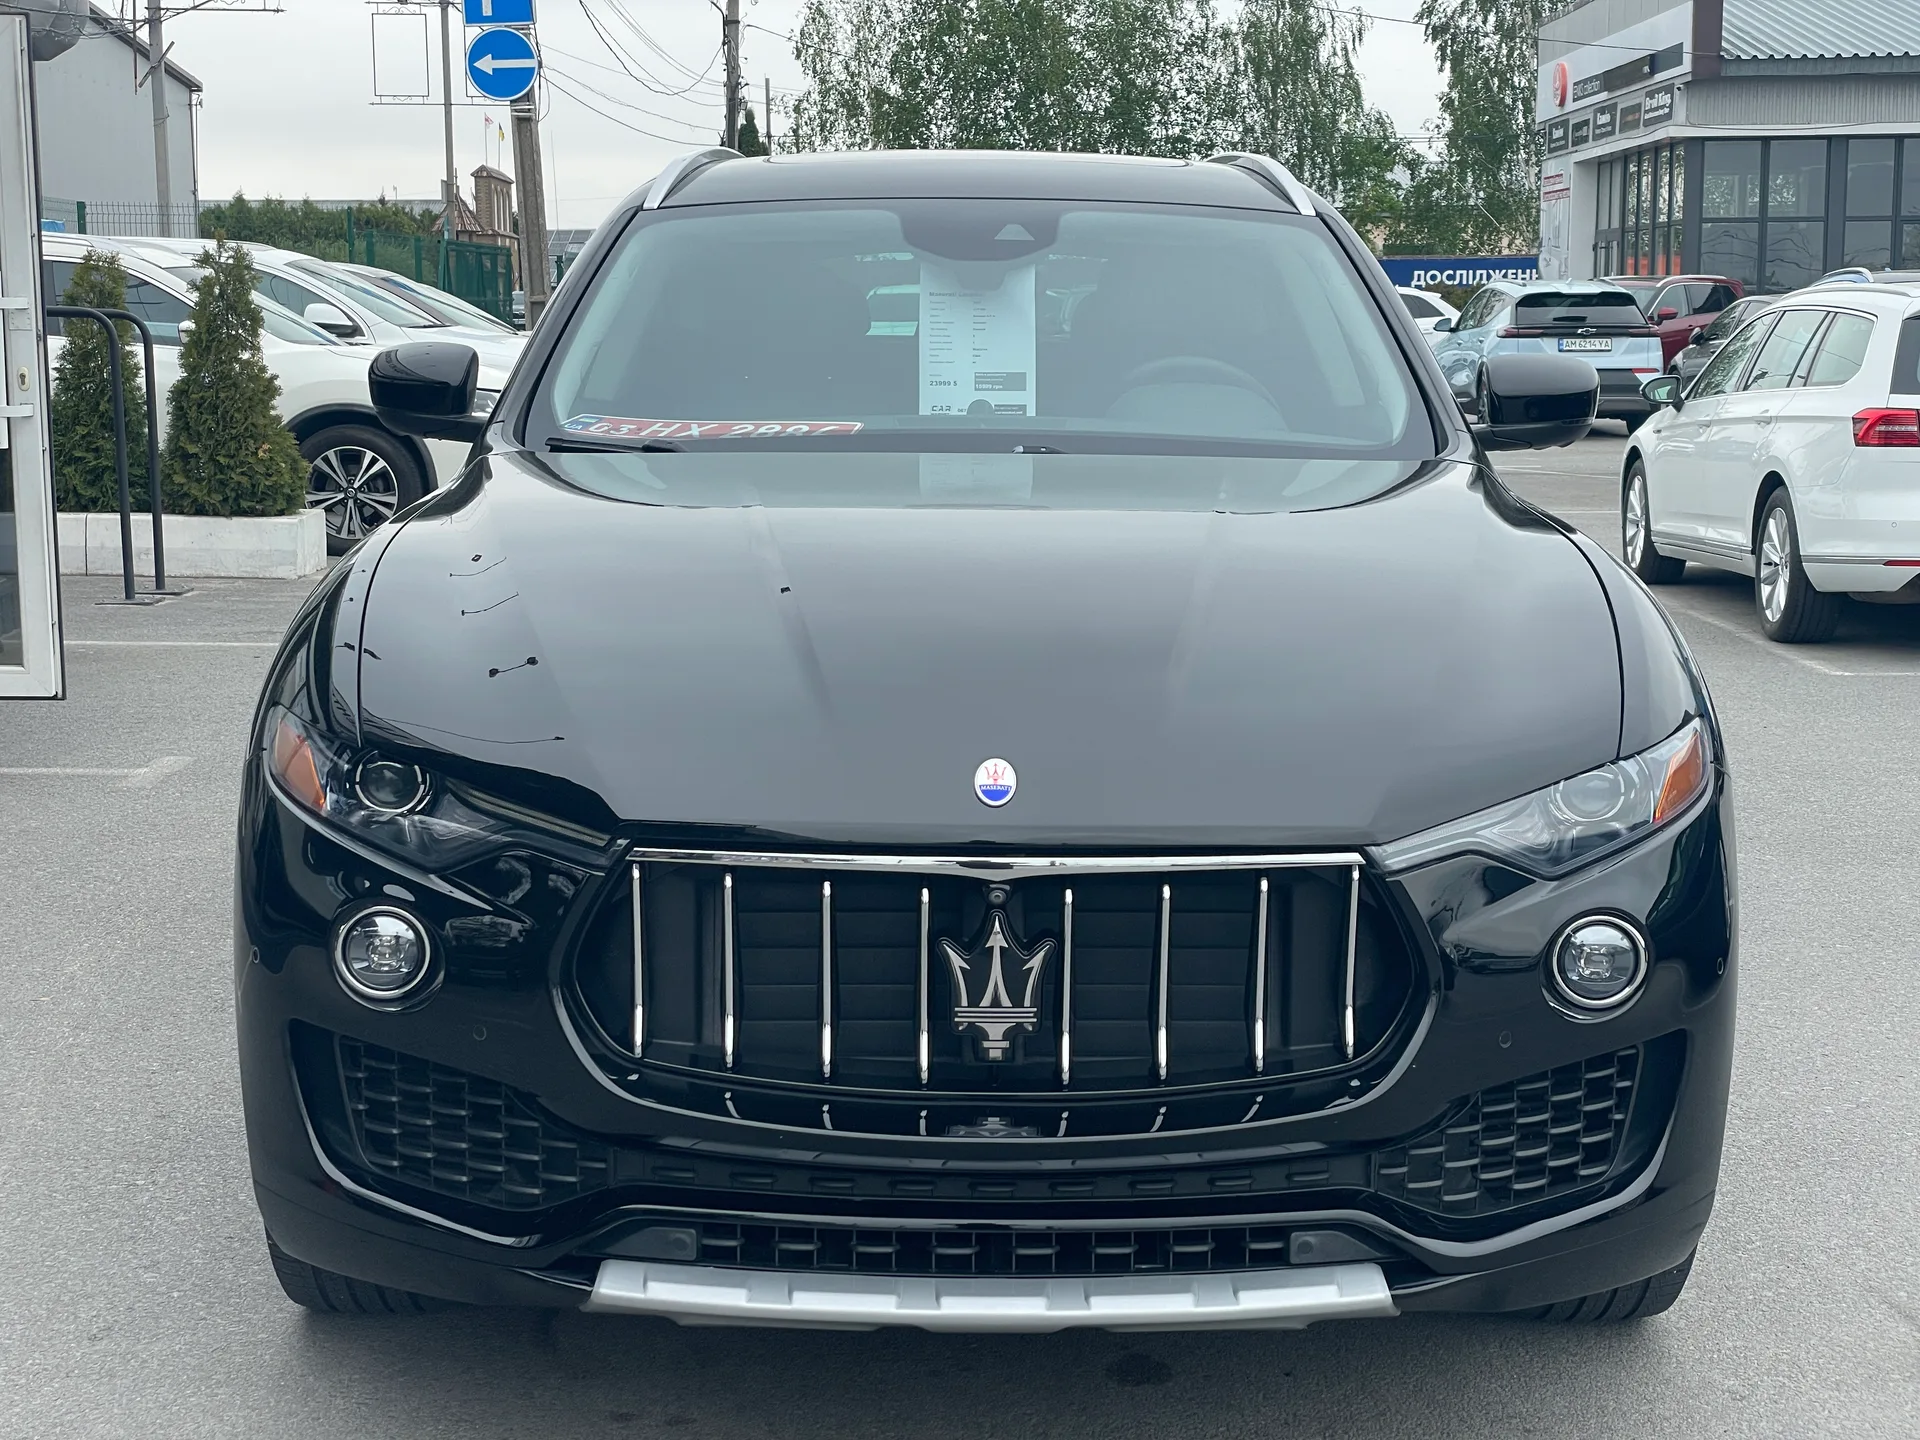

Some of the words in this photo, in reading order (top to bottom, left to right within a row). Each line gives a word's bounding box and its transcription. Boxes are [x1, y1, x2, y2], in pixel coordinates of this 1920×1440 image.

[1565, 340, 1577, 348] AM
[1579, 340, 1597, 348] 6214
[1599, 340, 1610, 348] YA
[588, 422, 637, 435] 03
[639, 422, 718, 438] HX
